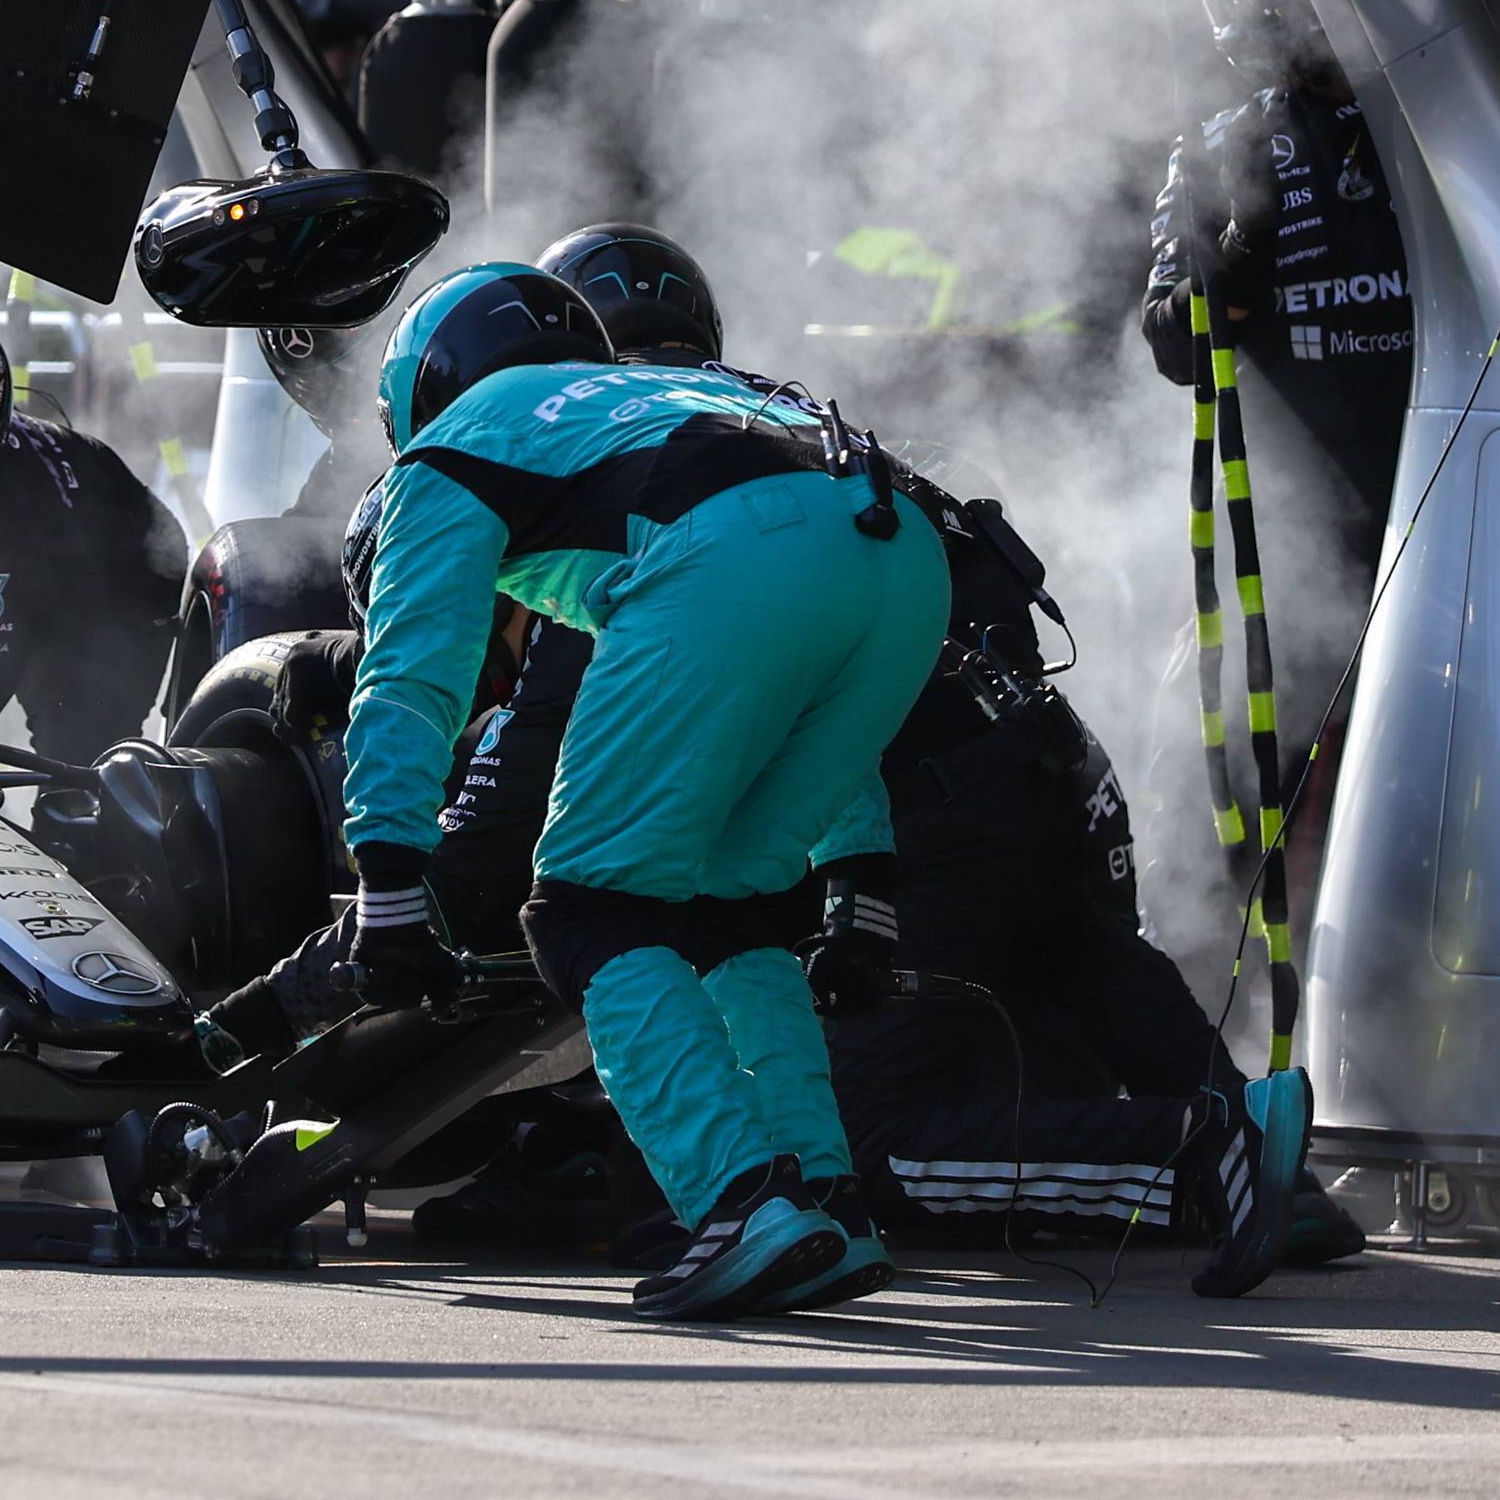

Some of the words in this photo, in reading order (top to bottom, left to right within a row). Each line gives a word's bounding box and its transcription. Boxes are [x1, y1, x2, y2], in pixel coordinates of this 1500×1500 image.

[1278, 215, 1323, 237] DSTRIKE
[1274, 268, 1411, 315] ETRON
[1329, 329, 1412, 355] Microso
[464, 775, 497, 788] LERA
[24, 918, 94, 937] SAP
